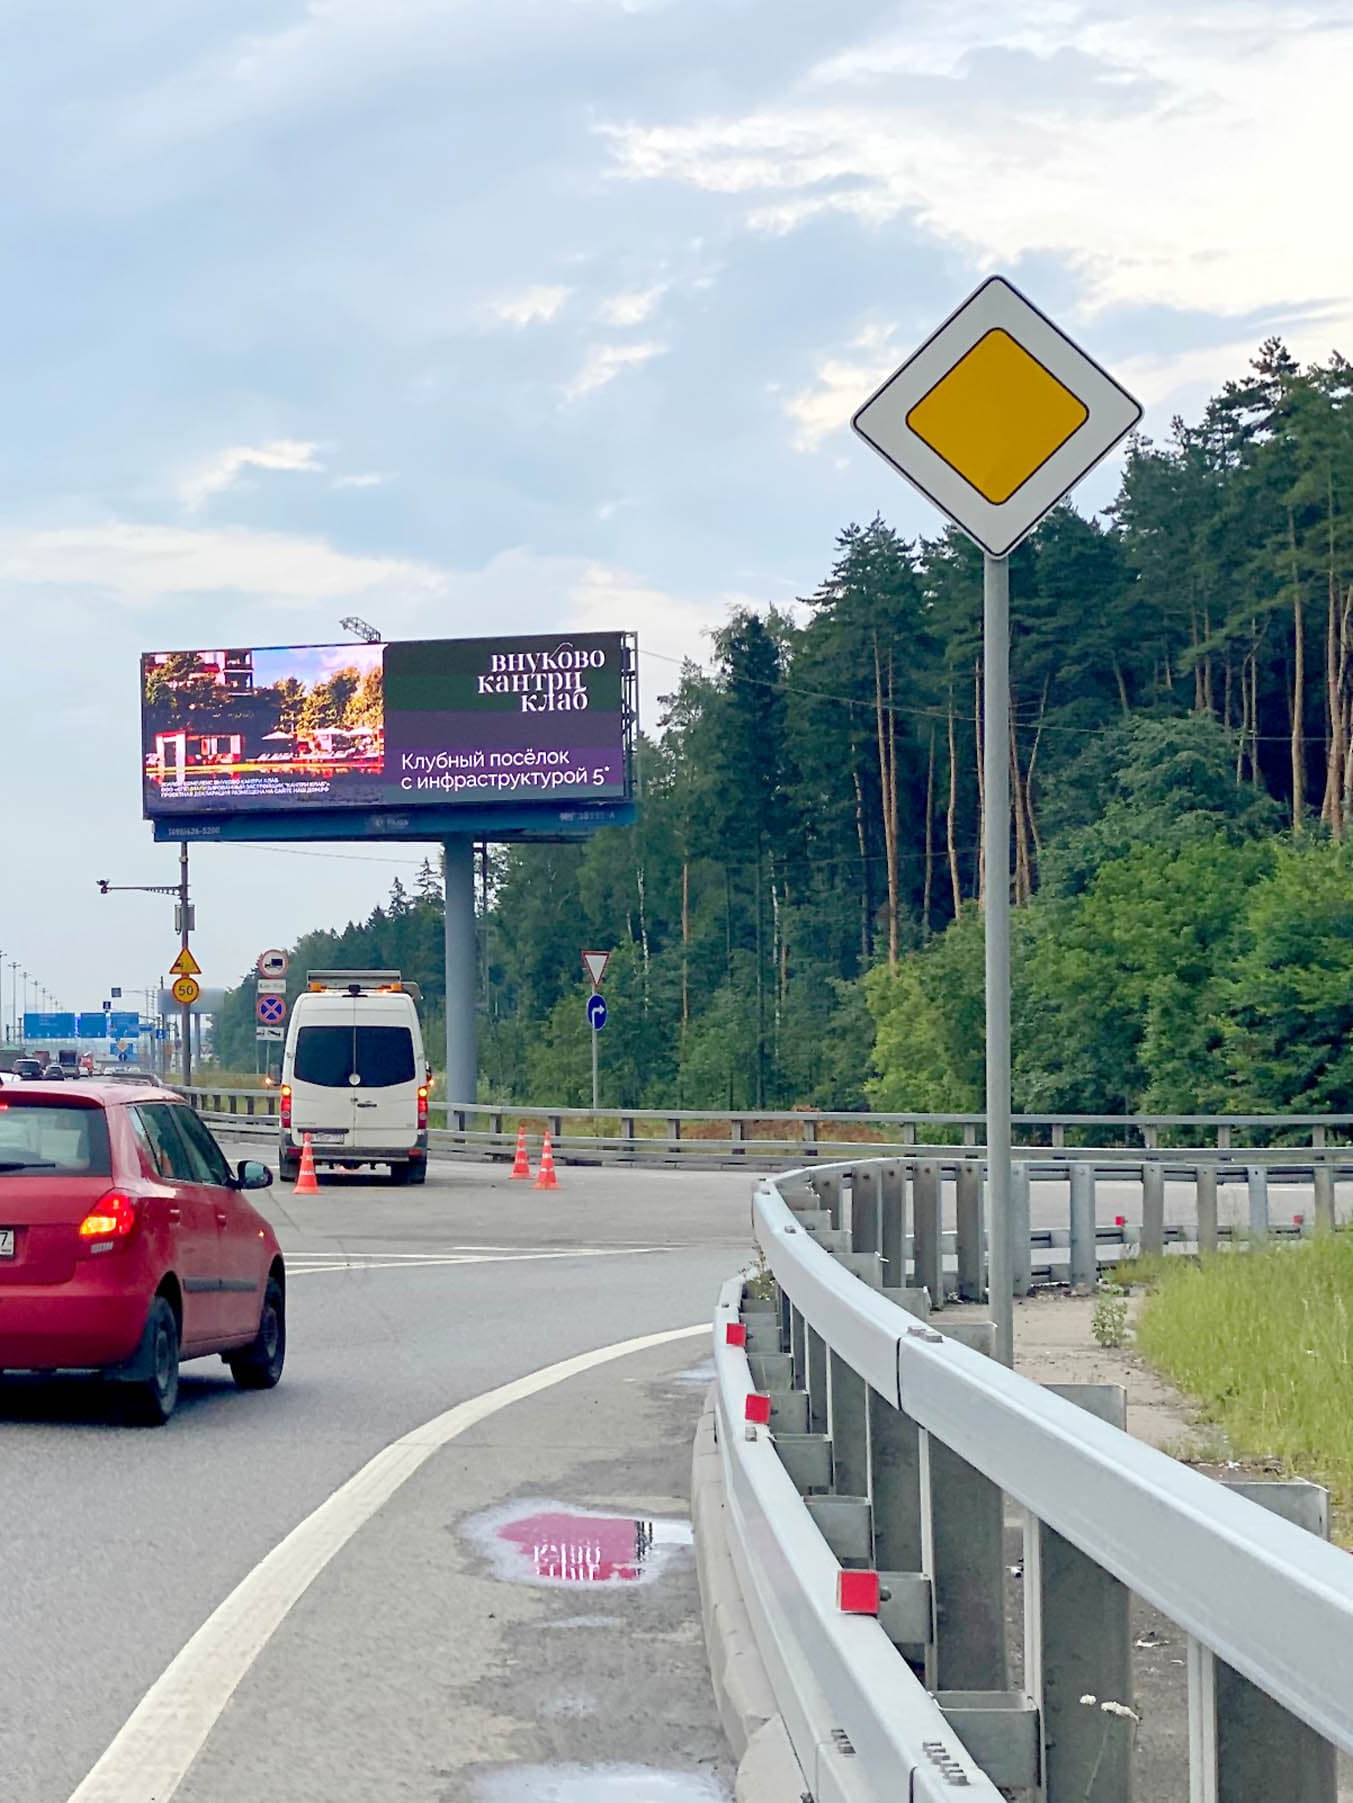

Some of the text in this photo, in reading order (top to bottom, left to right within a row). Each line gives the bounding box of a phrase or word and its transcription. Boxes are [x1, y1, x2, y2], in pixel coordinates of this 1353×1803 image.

[521, 686, 589, 712] клаб
[401, 748, 570, 773] Клубный посёлок
[401, 775, 412, 790] с
[417, 767, 588, 792] инфраструктурой
[178, 986, 193, 996] 50
